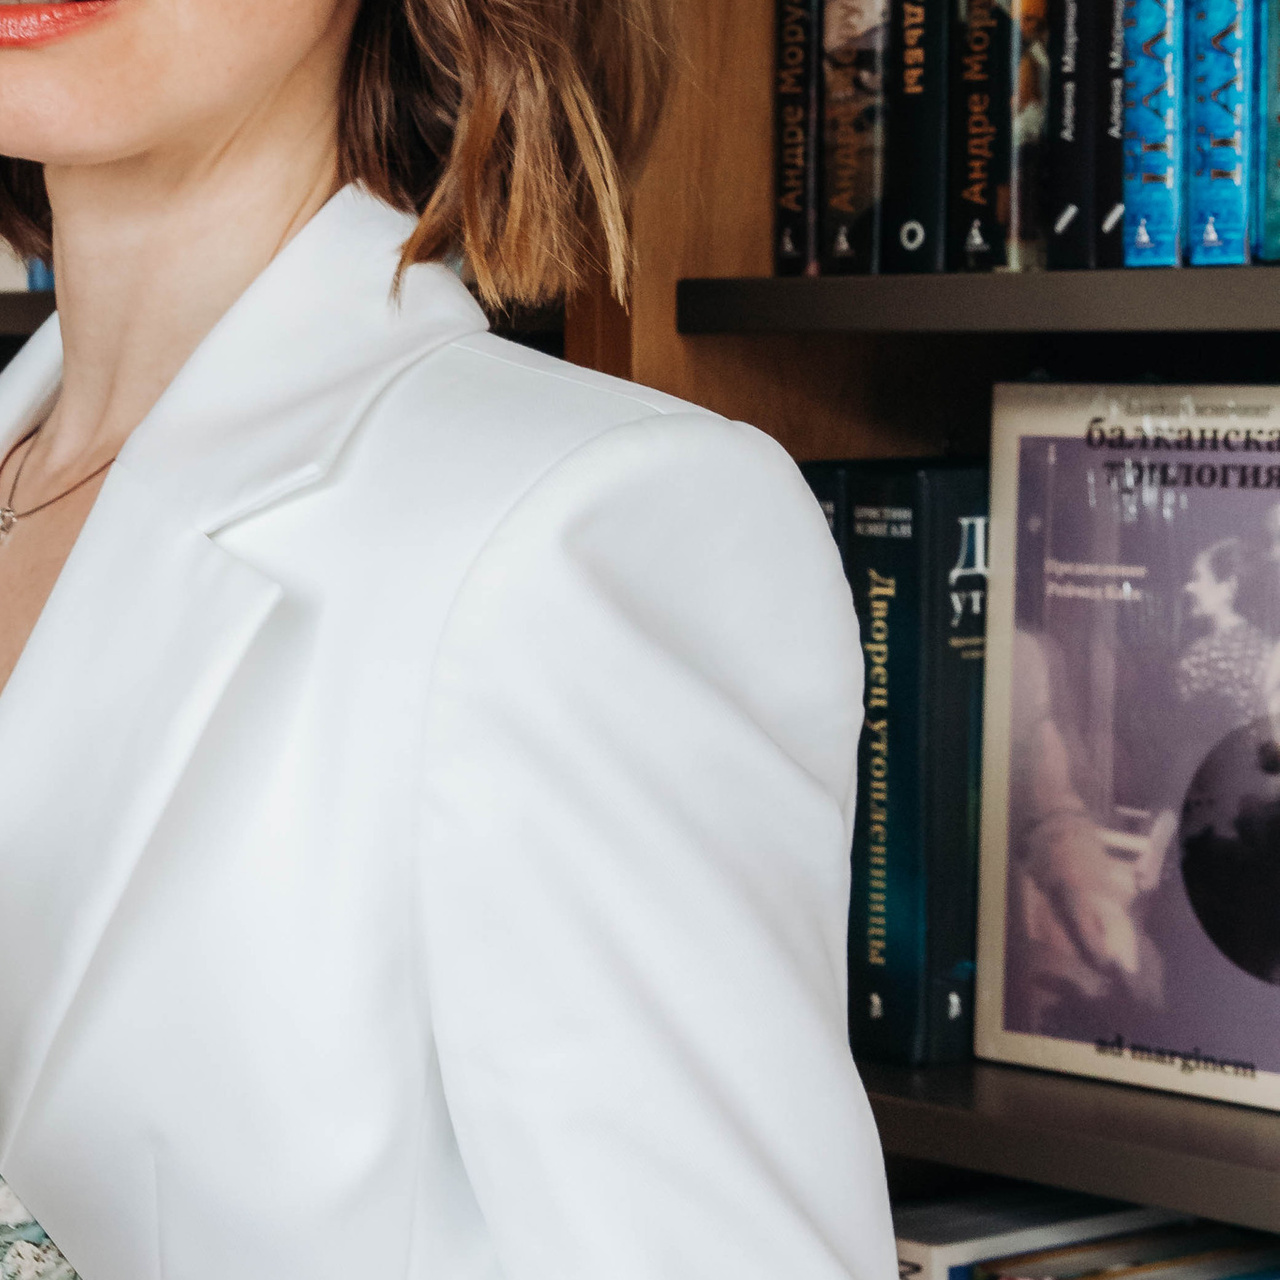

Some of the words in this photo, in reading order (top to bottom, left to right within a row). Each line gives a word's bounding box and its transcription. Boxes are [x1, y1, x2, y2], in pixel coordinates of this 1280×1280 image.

[778, 104, 805, 212] Андре
[961, 93, 997, 206] Андре
[865, 568, 897, 710] Дворец
